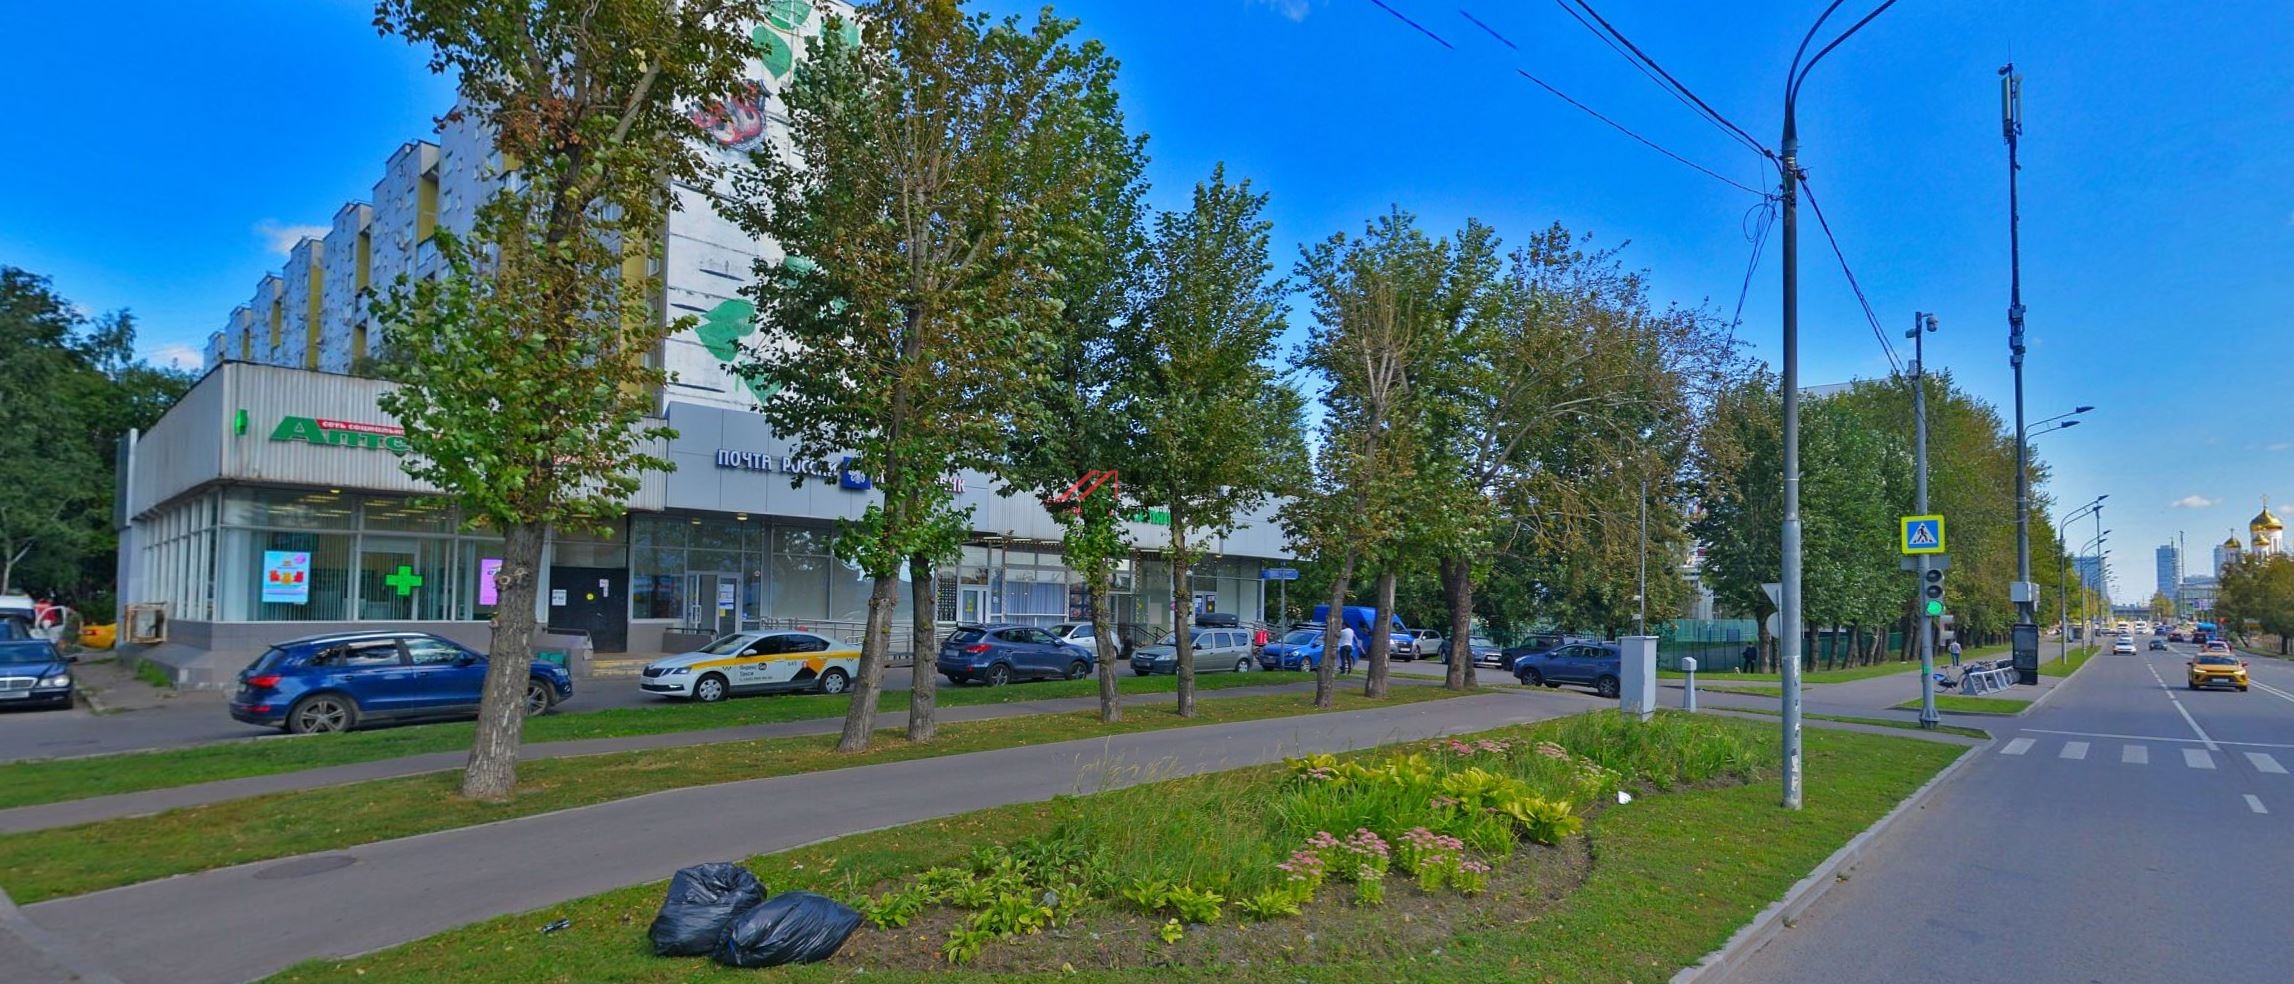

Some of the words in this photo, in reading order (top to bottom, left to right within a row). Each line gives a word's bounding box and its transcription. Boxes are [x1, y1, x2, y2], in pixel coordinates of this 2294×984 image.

[270, 416, 412, 452] Апте
[716, 449, 772, 471] ПОЧТА
[781, 455, 838, 477] РОССИ
